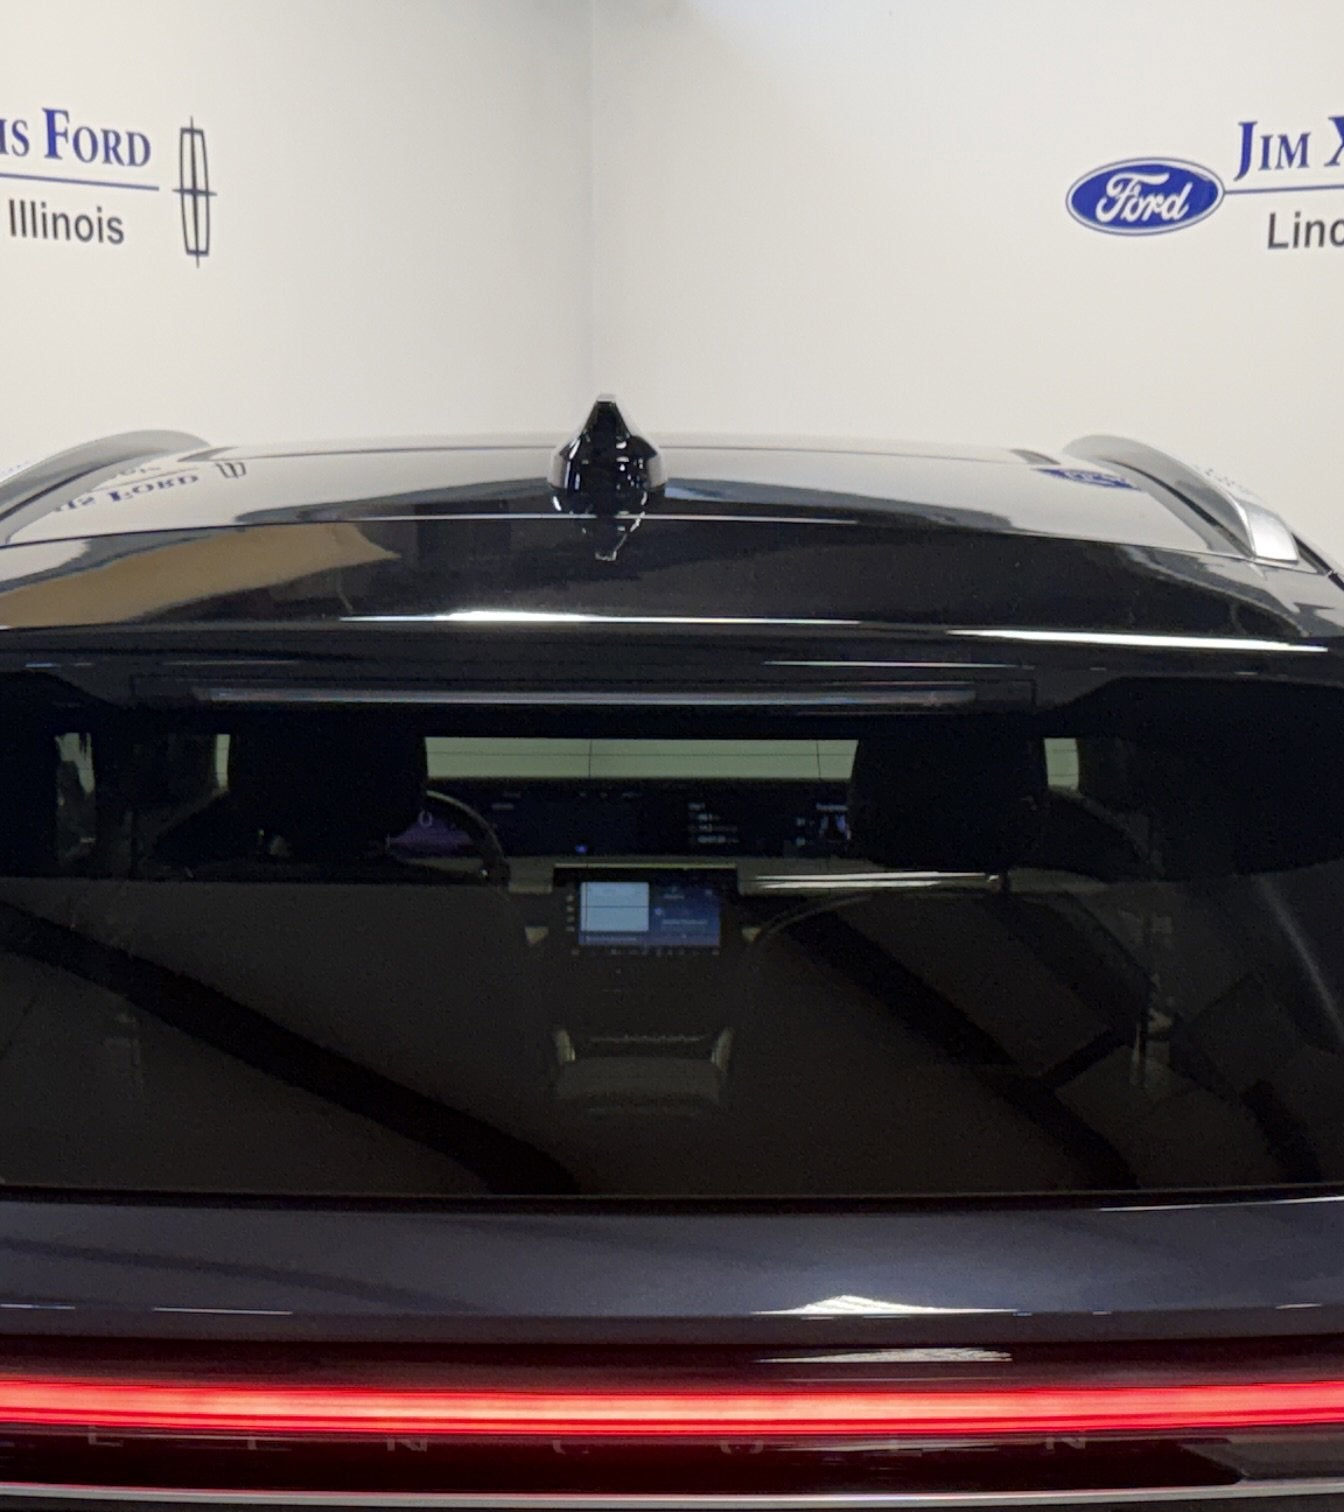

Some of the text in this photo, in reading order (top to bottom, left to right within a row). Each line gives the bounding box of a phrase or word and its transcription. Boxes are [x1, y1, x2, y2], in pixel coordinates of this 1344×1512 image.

[42, 108, 151, 167] FORD
[1234, 120, 1311, 181] JIM
[9, 200, 124, 245] Illinois
[1095, 173, 1190, 222] Ford
